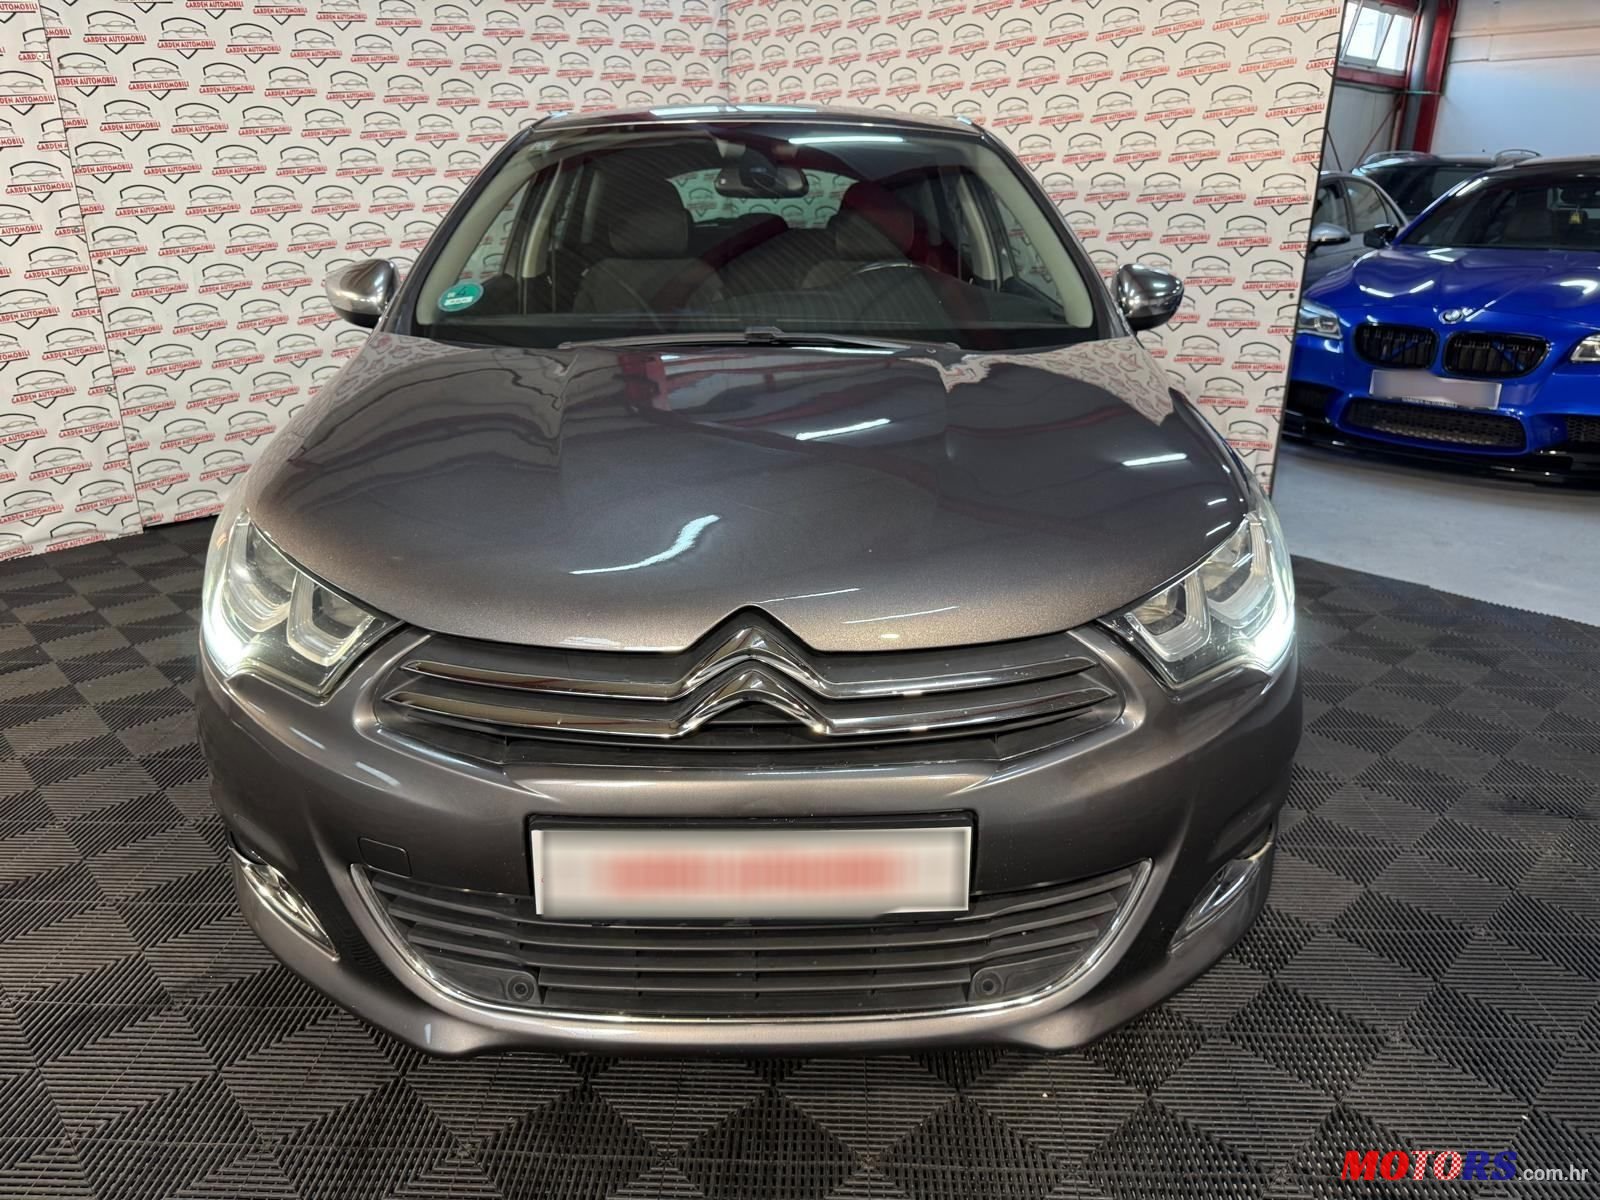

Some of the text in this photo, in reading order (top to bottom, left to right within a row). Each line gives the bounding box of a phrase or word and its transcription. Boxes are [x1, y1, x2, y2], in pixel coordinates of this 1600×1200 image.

[209, 0, 243, 8] AUTOMOBILI
[1302, 5, 1340, 22] AUTOMOBILI
[1235, 13, 1269, 27] AUTOMOBILI
[109, 35, 146, 43] AUTOMOBILI
[181, 40, 217, 48] AUTOMOBILI
[1261, 57, 1297, 71] AUTOMOBILI
[80, 75, 117, 86] AUTOMOBILI
[152, 81, 188, 90] AUTOMOBILI
[1288, 102, 1325, 116] AUTOMOBILI
[124, 121, 160, 131] AUTOMOBILI
[194, 123, 228, 133] AUTOMOBILI
[1250, 149, 1285, 161] AUTOMOBILI
[97, 163, 133, 173] AUTOMOBILI
[167, 164, 202, 174] AUTOMOBILI
[32, 182, 73, 193] AUTOMOBILI
[140, 203, 175, 215] AUTOMOBILI
[112, 244, 147, 257] AUTOMOBILI
[50, 264, 90, 277] AUTOMOBILI
[1265, 281, 1300, 290] AUTOMOBILI
[67, 344, 106, 357] AUTOMOBILI
[37, 385, 75, 399] AUTOMOBILI
[83, 418, 121, 434] AUTOMOBILI
[53, 461, 90, 476] AUTOMOBILI
